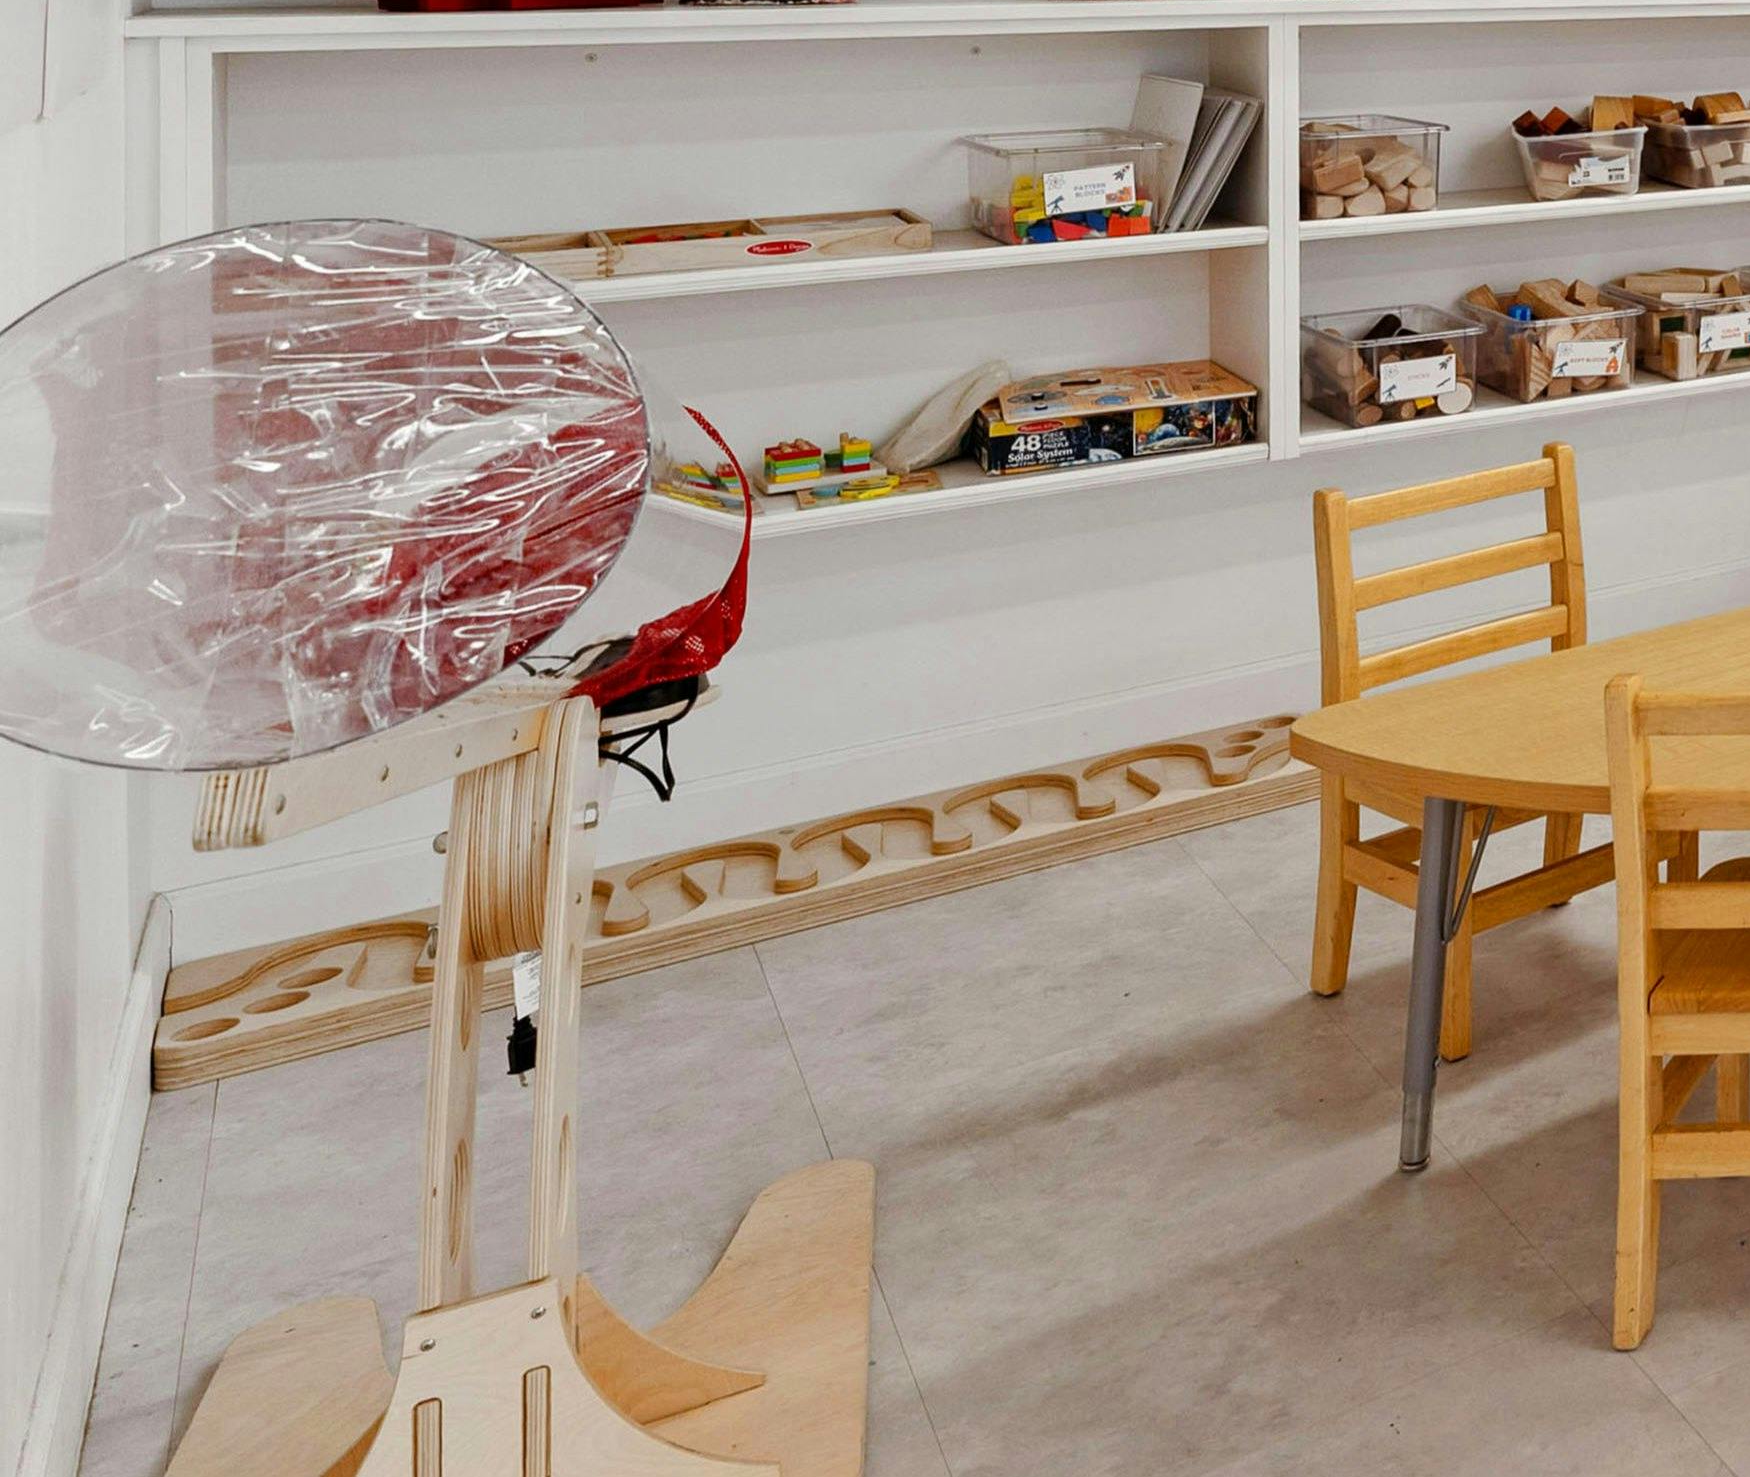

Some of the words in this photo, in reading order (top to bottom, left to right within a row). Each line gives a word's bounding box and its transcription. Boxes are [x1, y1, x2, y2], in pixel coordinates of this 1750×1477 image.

[1073, 182, 1107, 192] PATTERN
[1011, 435, 1041, 452] 48
[1008, 452, 1035, 464] Solar
[1036, 448, 1073, 461] System
